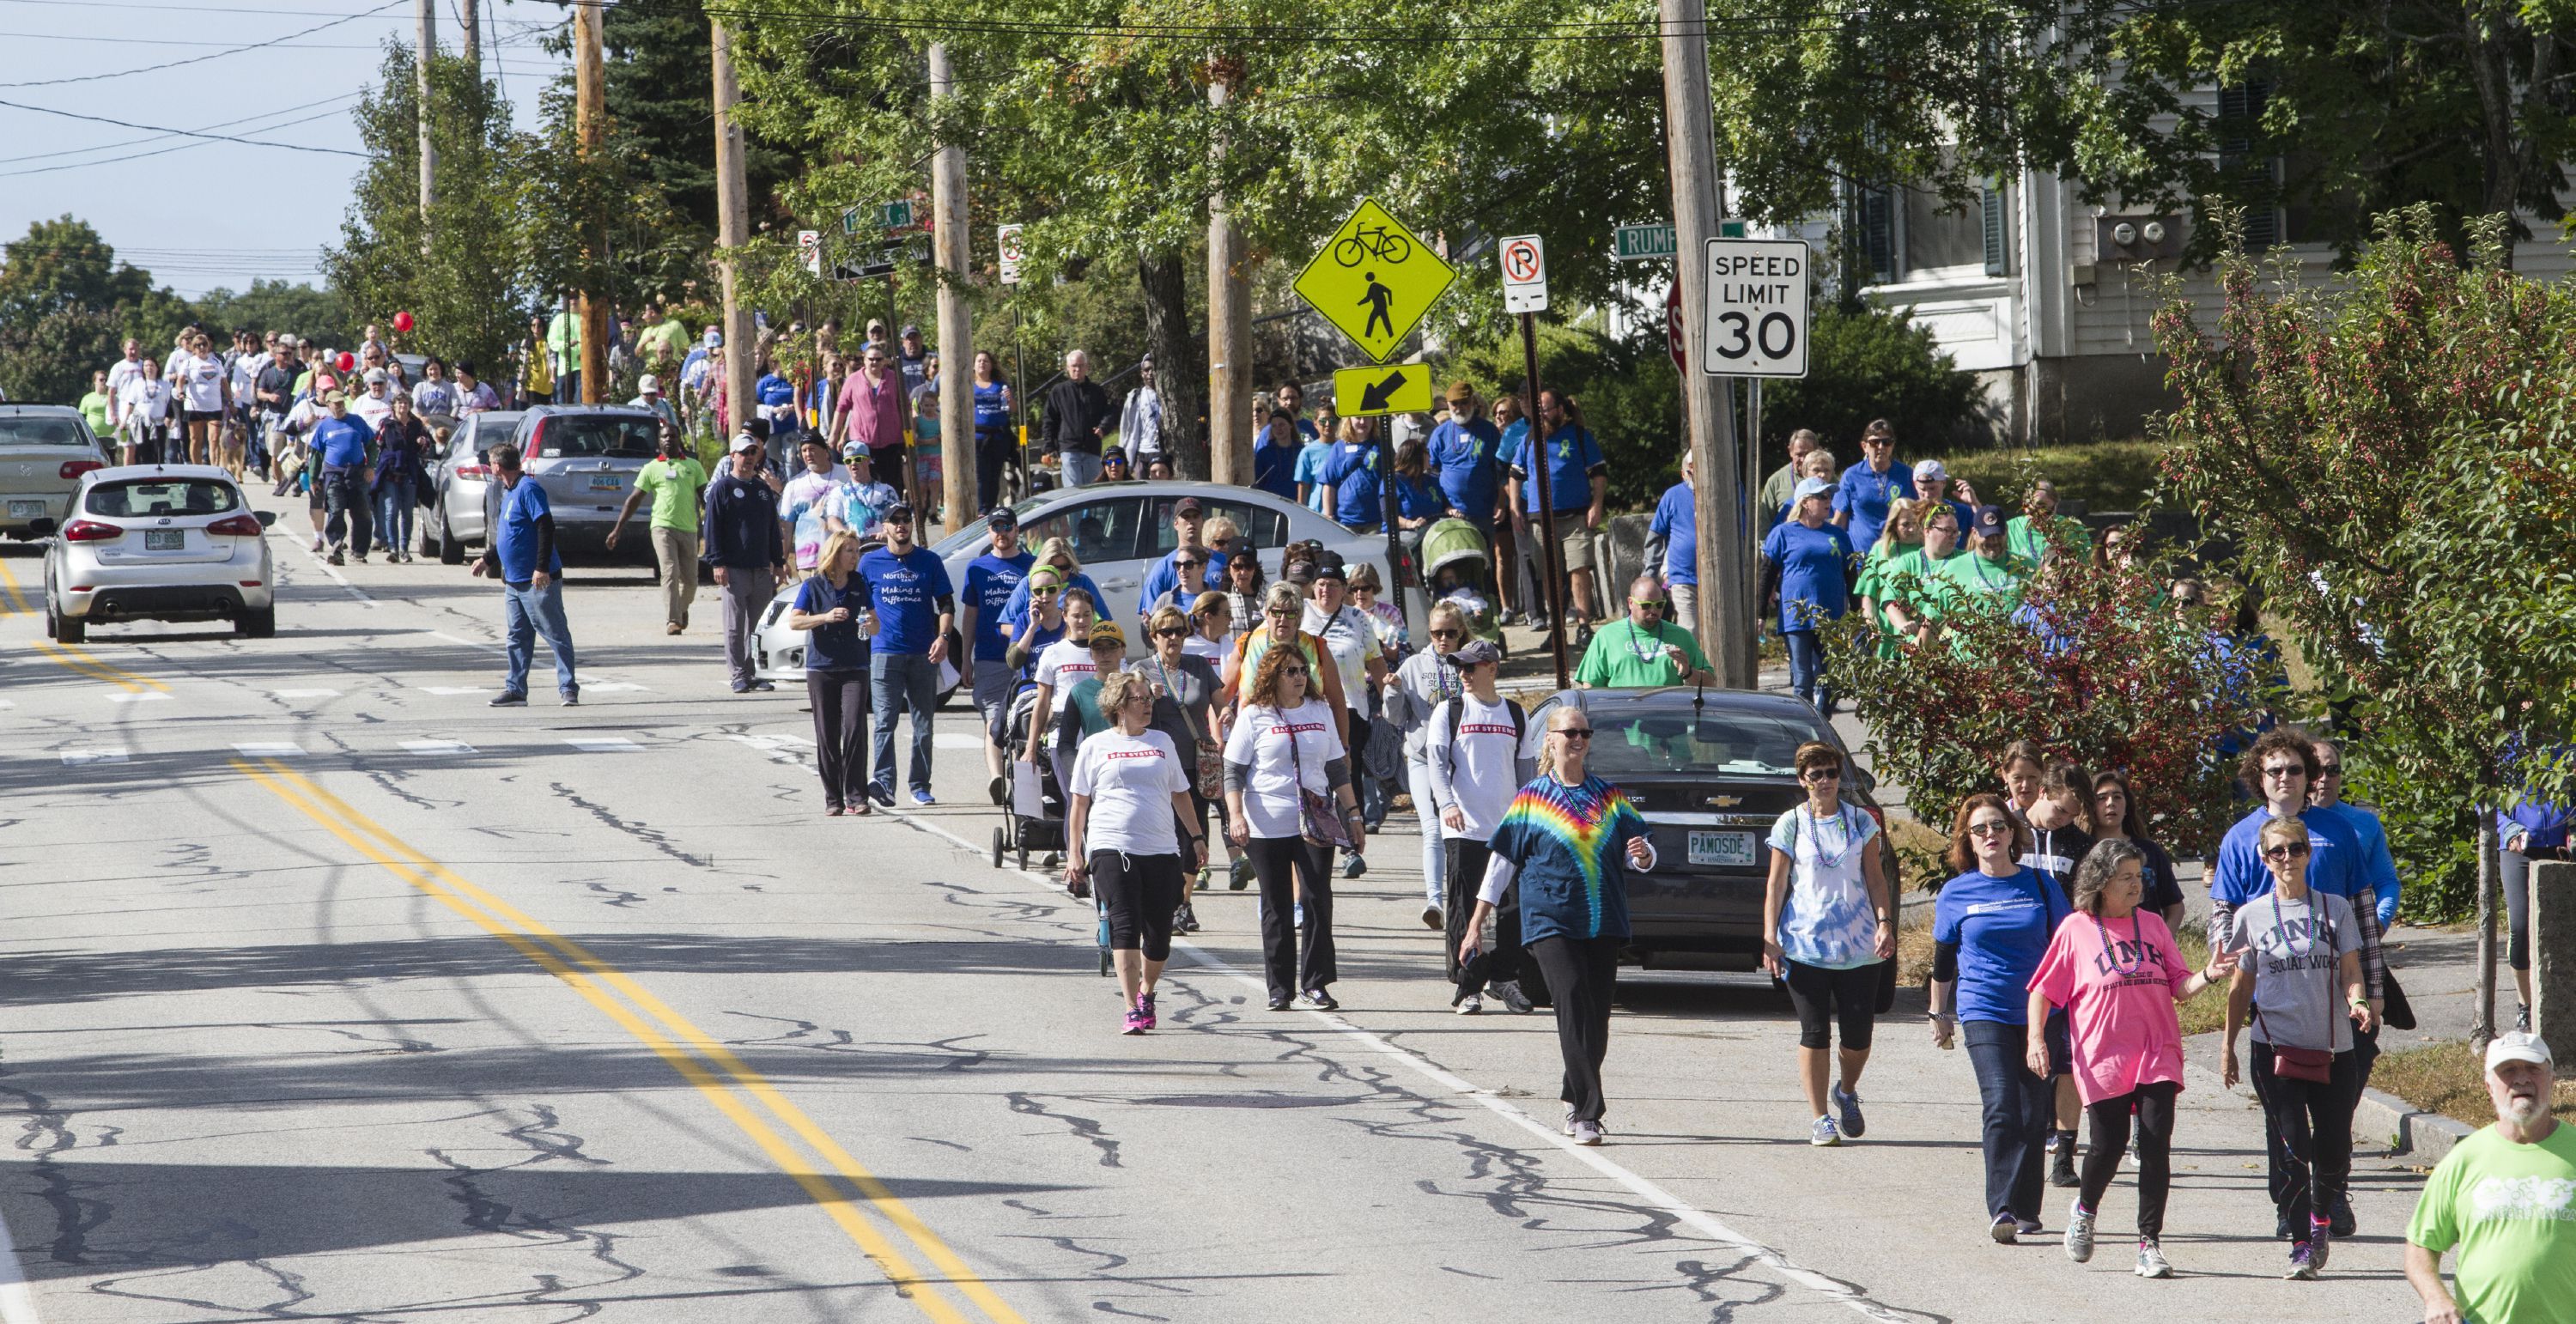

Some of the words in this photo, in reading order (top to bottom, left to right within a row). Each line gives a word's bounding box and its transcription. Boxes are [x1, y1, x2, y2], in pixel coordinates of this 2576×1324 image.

[1627, 228, 1676, 254] RUMF
[1715, 256, 1800, 276] SPEED
[1723, 283, 1790, 304] LIMIT
[1716, 311, 1795, 361] 30
[883, 571, 919, 581] Northway
[881, 586, 913, 595] Making
[985, 587, 1014, 596] Makin
[882, 596, 921, 605] Difference
[985, 597, 1008, 606] Differ
[1482, 726, 1516, 736] SYSTEMS
[1691, 837, 1745, 854] PAMOSDE
[2260, 917, 2341, 955] UNH
[2094, 939, 2166, 976] UNH
[2269, 956, 2306, 974] SOCIAL
[2103, 981, 2123, 992] HEALTH
